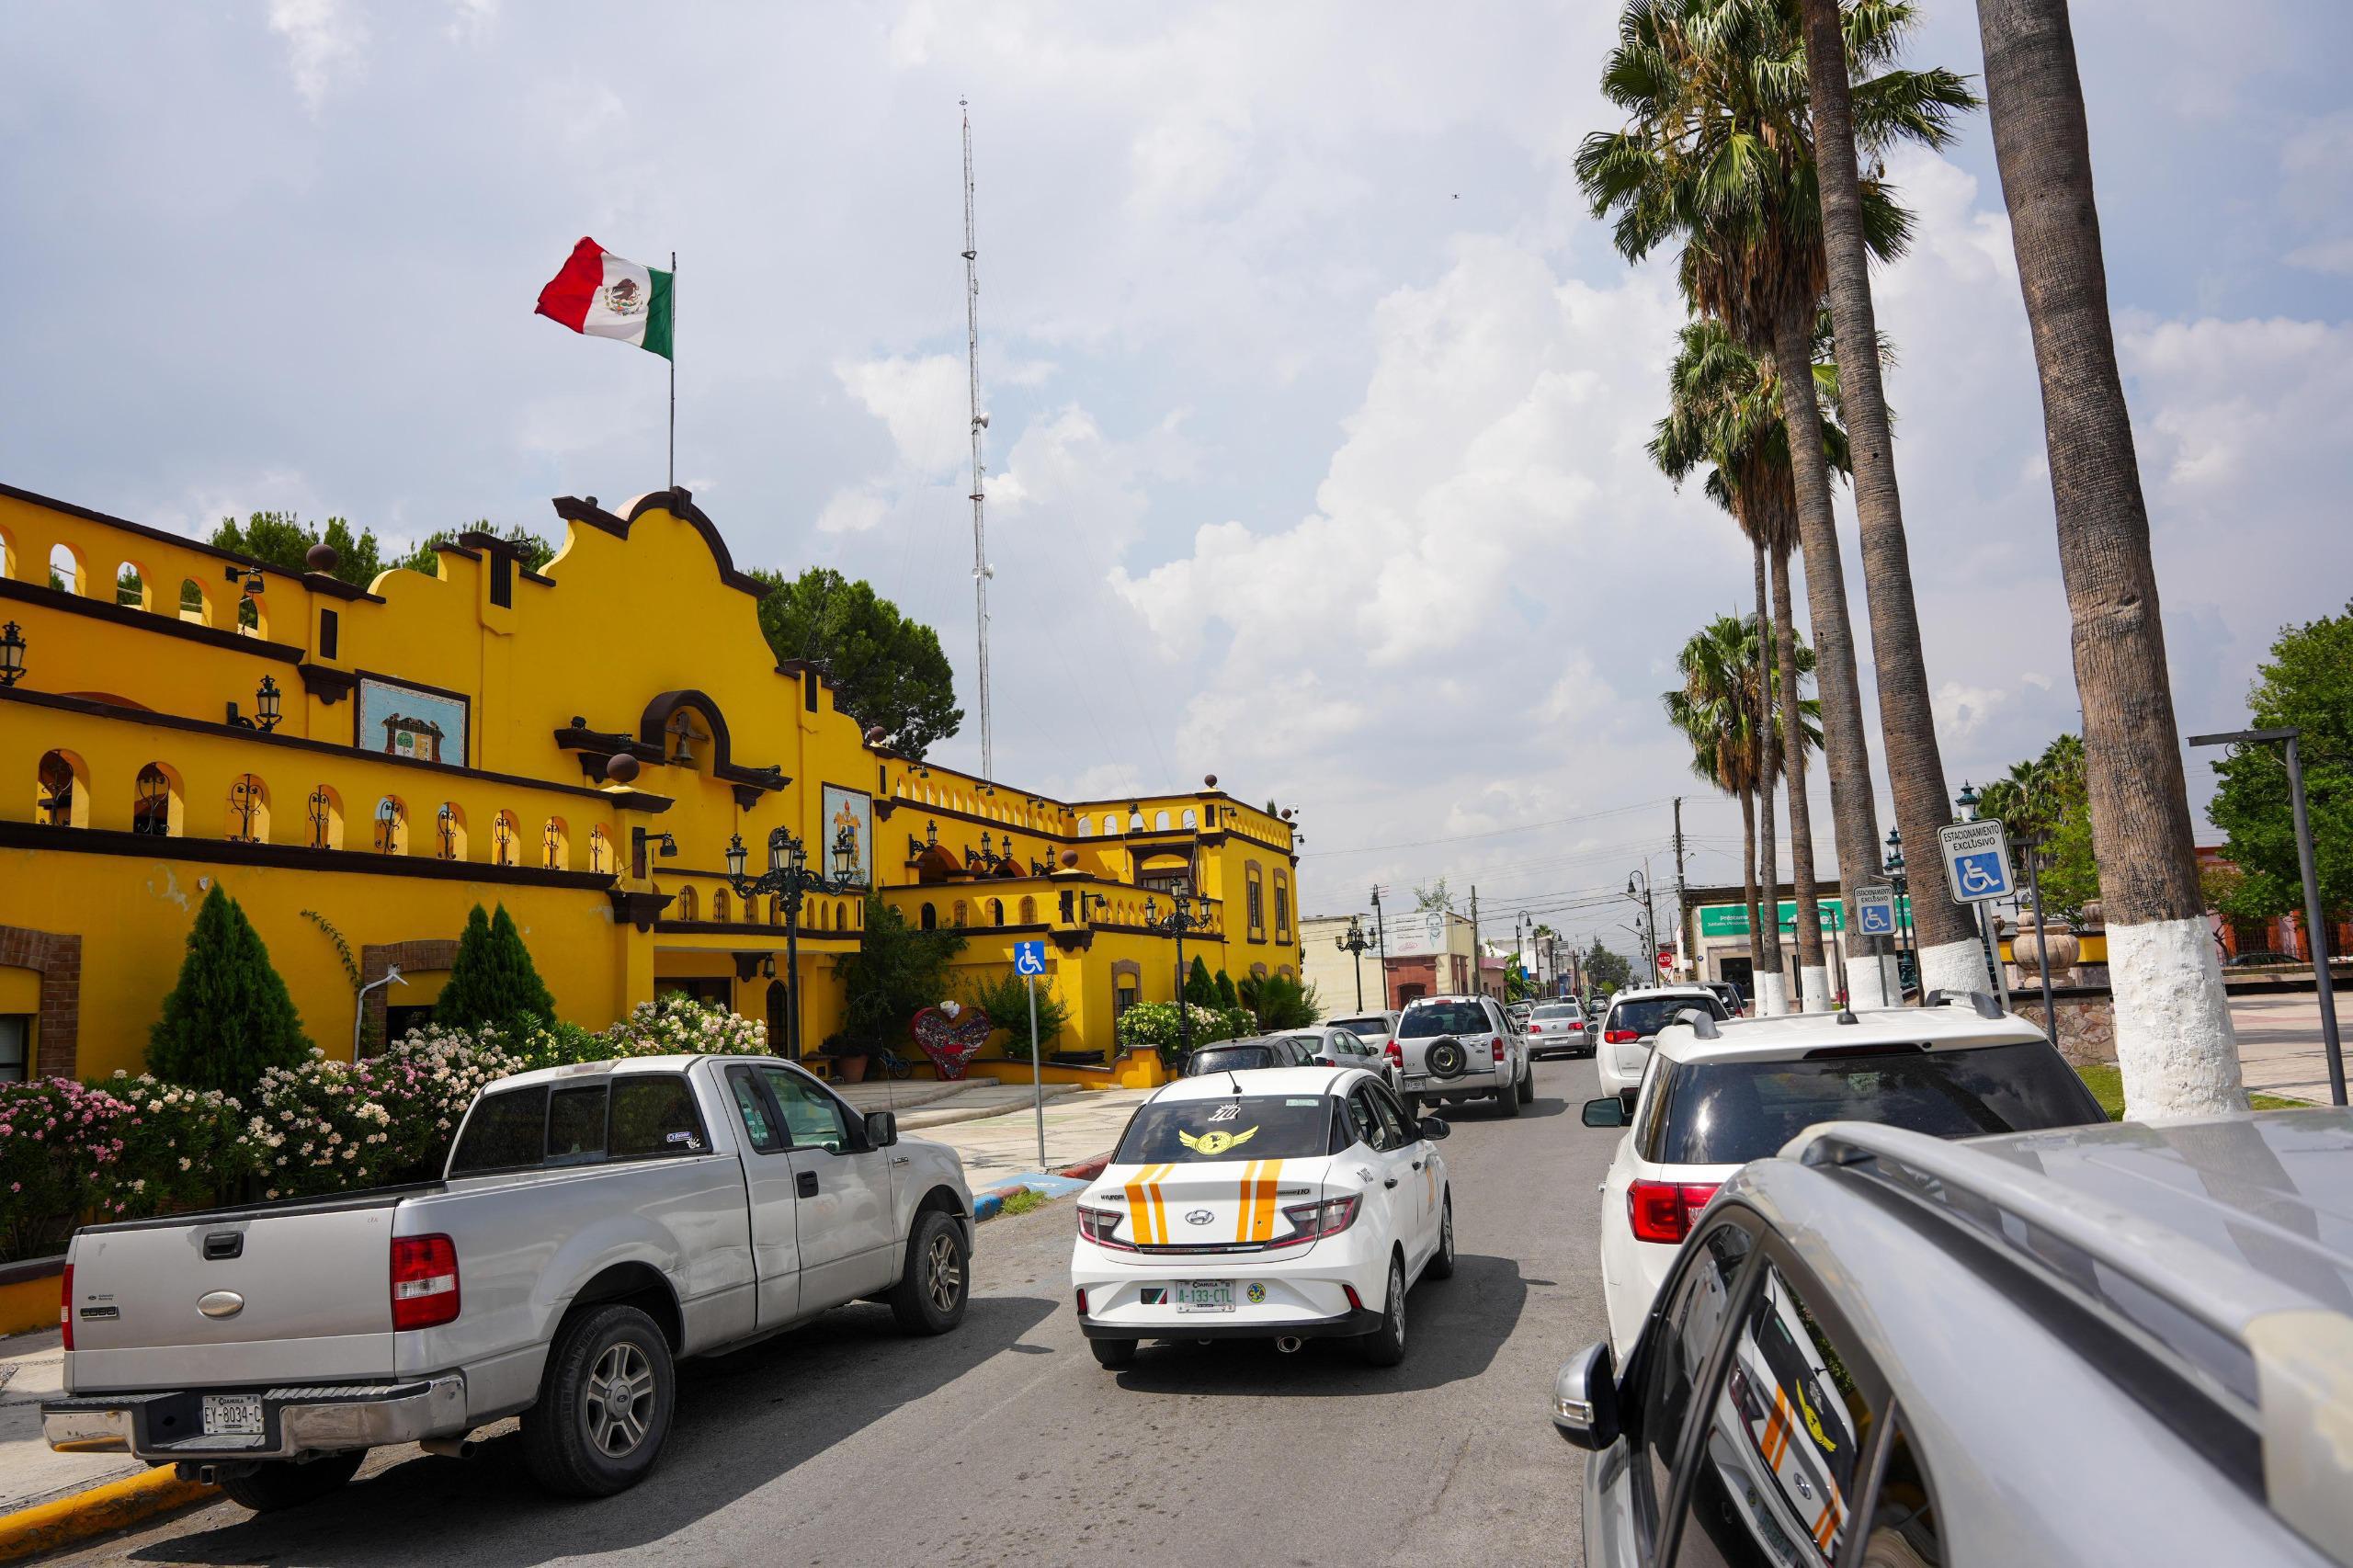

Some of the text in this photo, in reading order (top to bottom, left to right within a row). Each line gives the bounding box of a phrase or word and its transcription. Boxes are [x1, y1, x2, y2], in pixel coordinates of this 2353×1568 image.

[1943, 824, 2000, 843] ESTACIONAMIENTO
[1953, 836, 1995, 851] EXCLUSIVO
[1856, 888, 1892, 897] ESTACIONAMIENTO
[1861, 895, 1889, 903] EXCLUSIVO
[1178, 1289, 1233, 1303] A-133-CTL
[218, 1397, 244, 1406] COAHUILA
[204, 1405, 261, 1424] EY-8034-C
